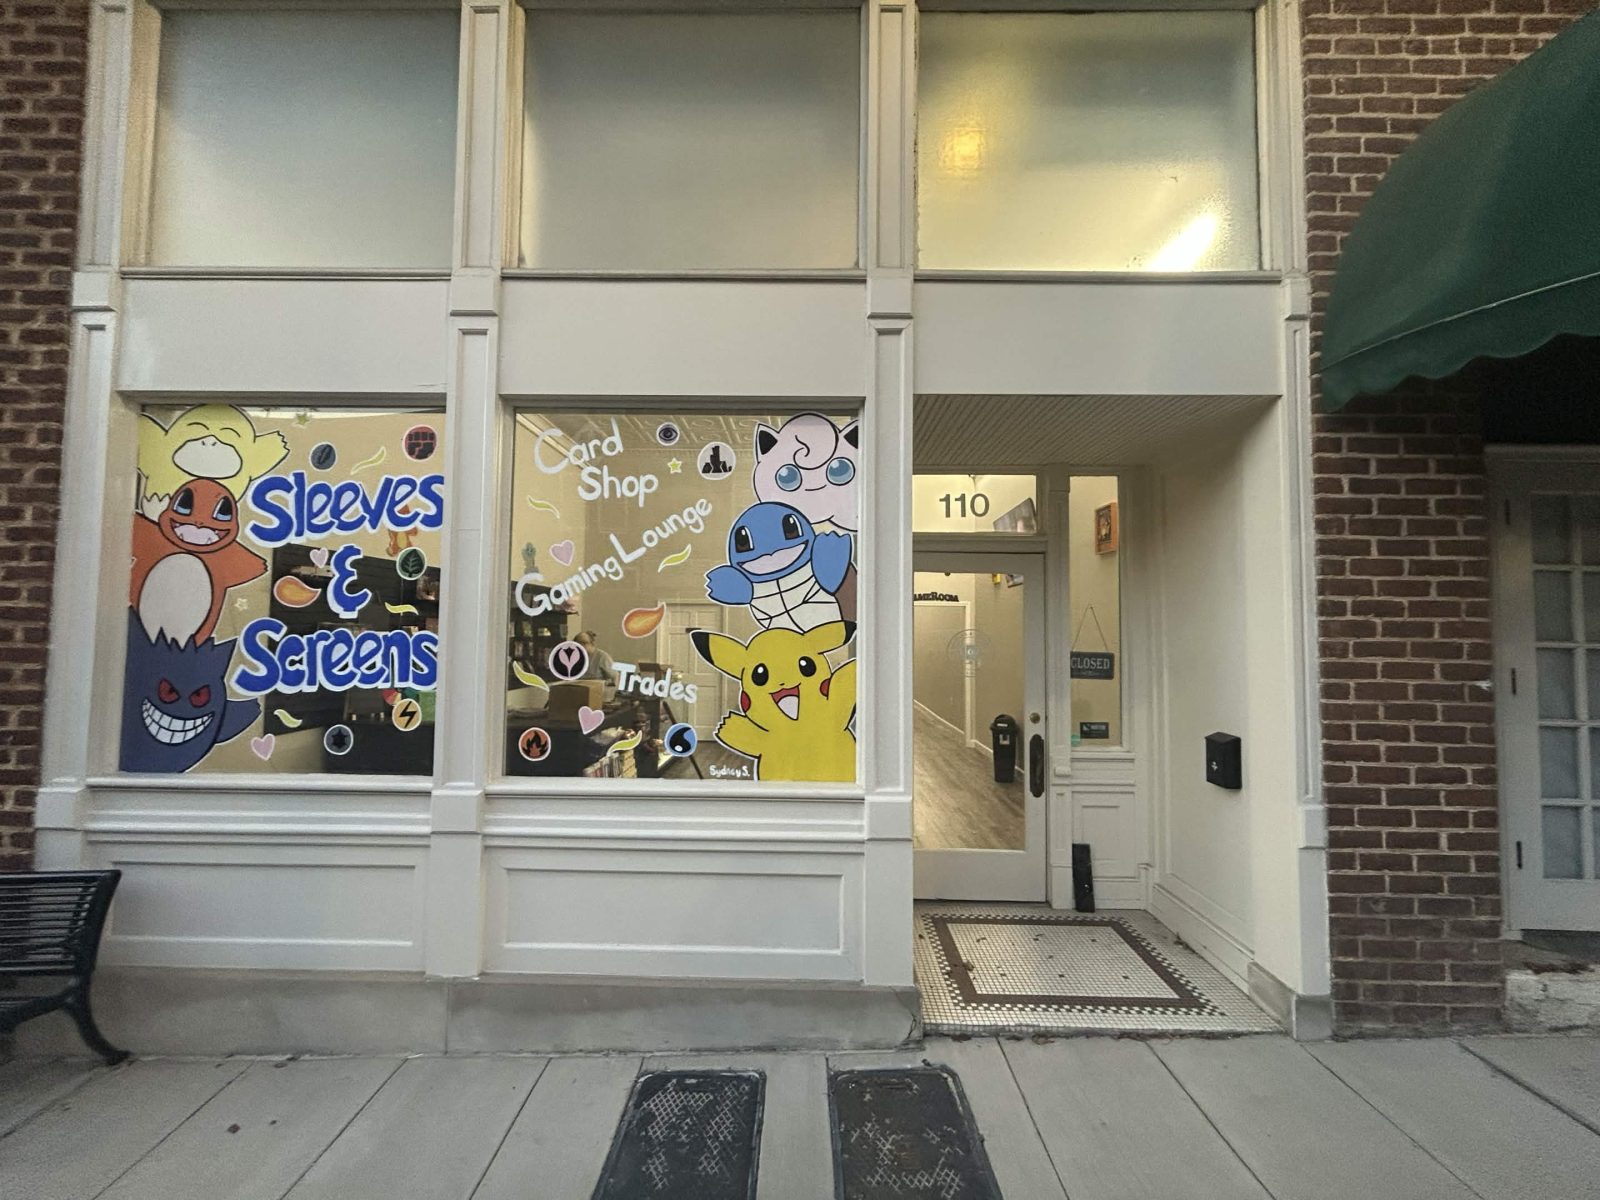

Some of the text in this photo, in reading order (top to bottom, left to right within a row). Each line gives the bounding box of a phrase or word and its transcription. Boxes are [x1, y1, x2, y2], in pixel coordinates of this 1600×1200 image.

[534, 417, 624, 474] Card
[246, 471, 444, 547] Sleeves
[577, 464, 659, 508] Shop
[938, 492, 990, 518] 110
[326, 544, 372, 619] &
[514, 498, 713, 617] Gaming Lounge
[230, 616, 439, 695] Screens
[611, 661, 698, 704] Trades
[1070, 657, 1110, 670] CLOSED
